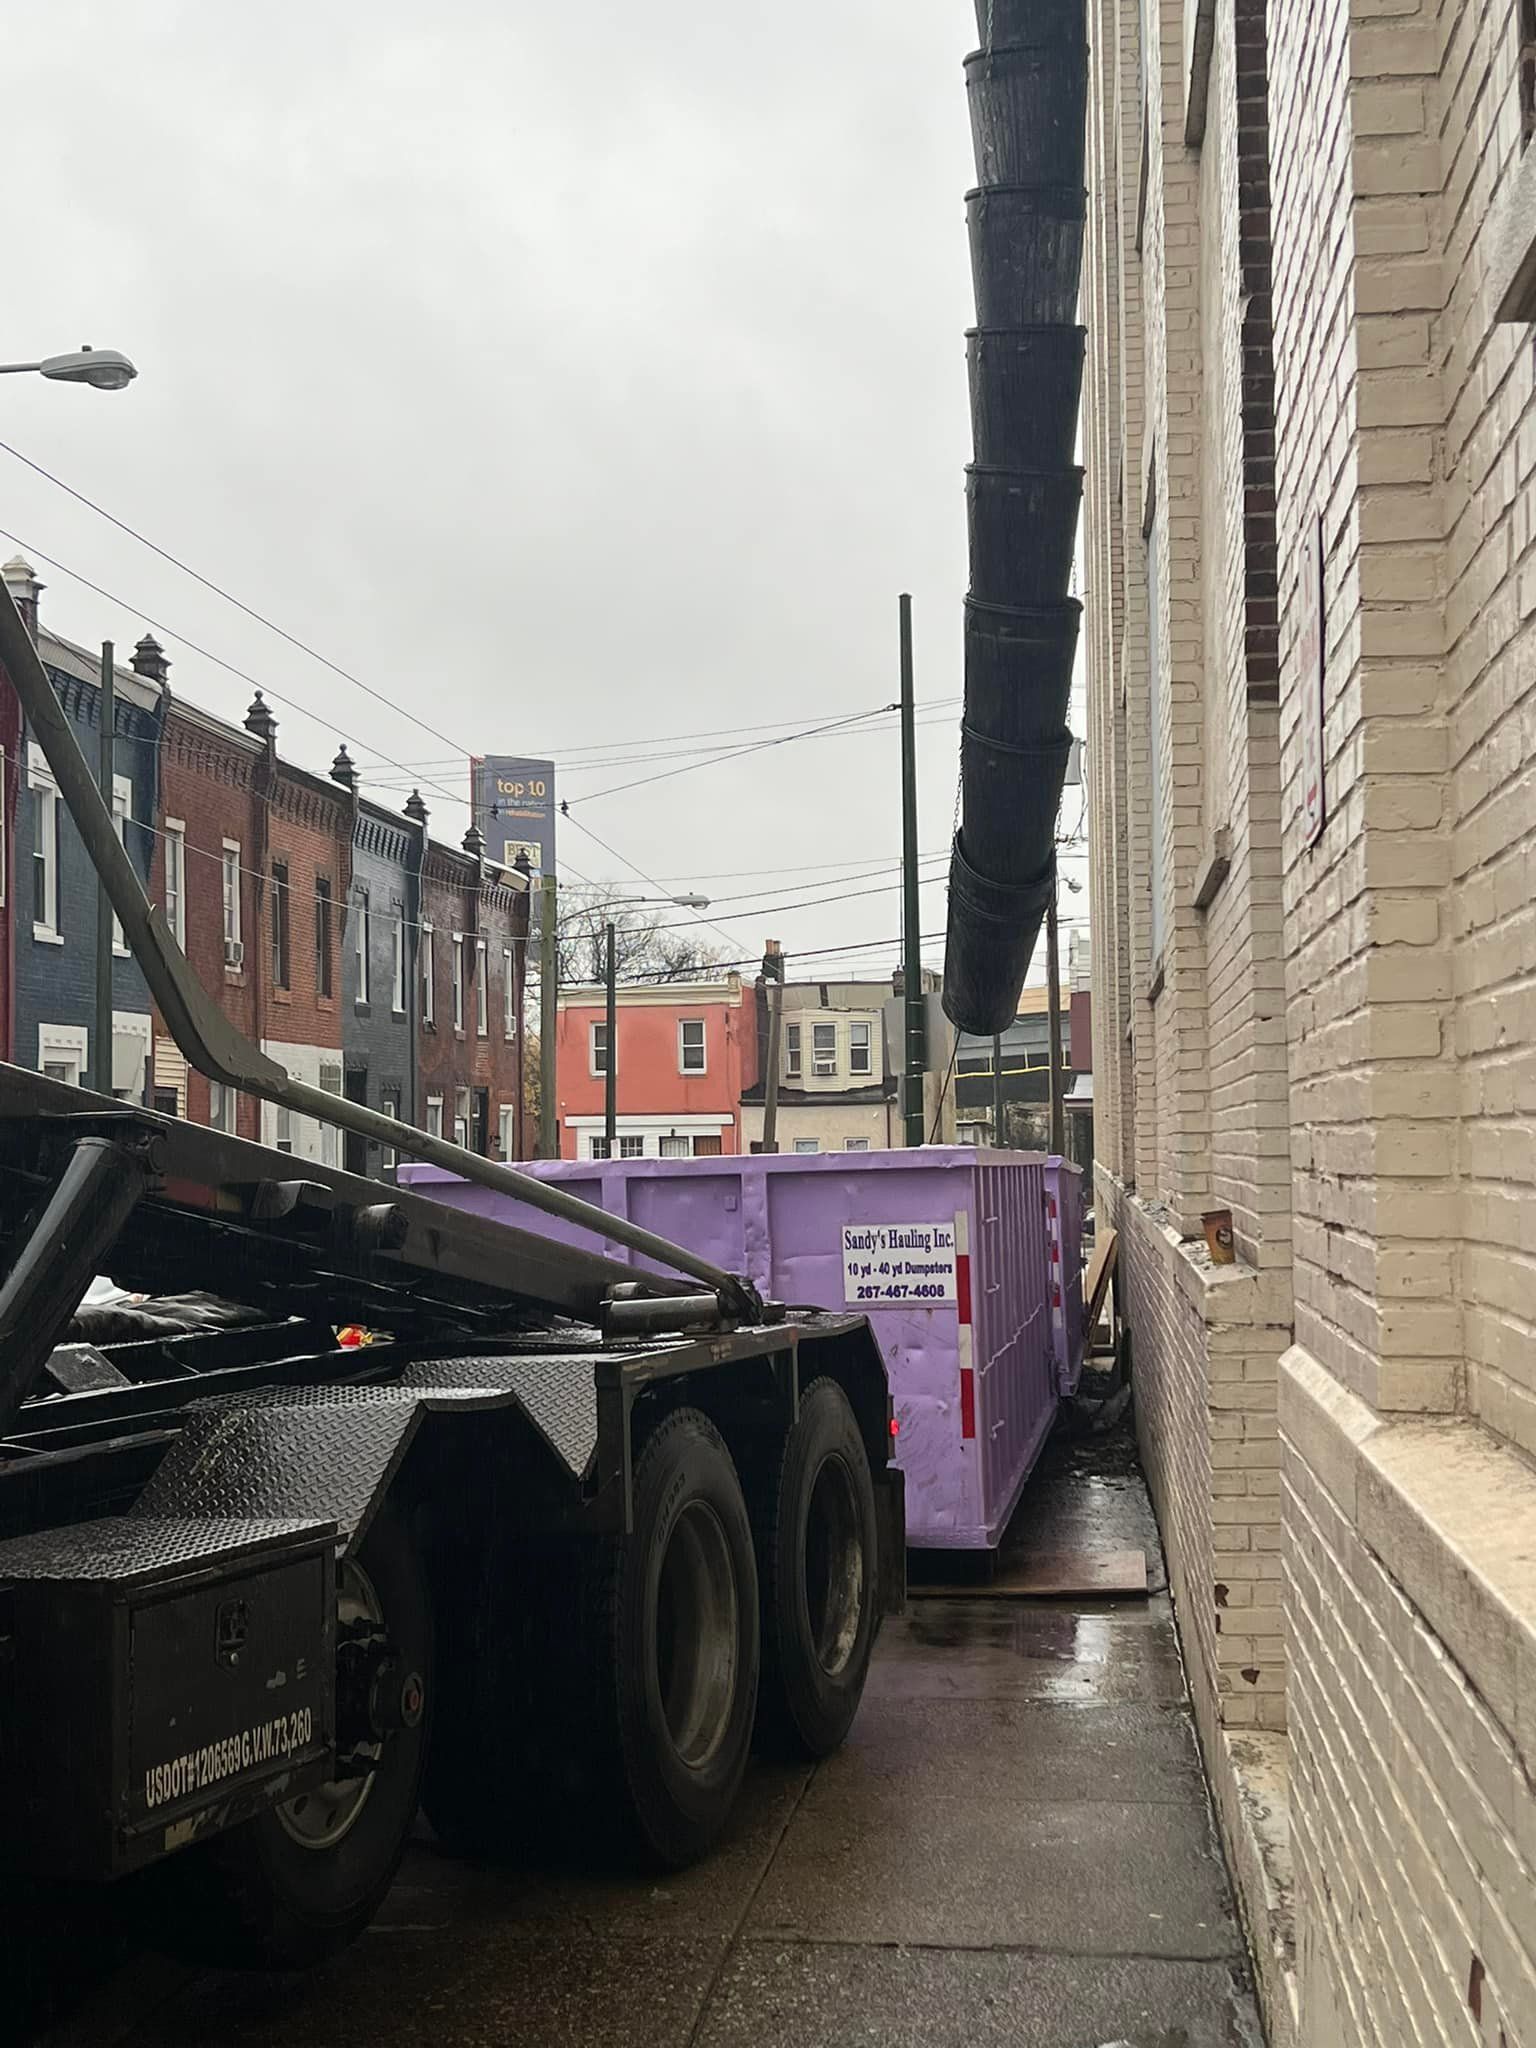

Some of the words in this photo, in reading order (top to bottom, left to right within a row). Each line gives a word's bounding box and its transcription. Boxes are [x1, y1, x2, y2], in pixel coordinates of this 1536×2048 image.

[496, 778, 525, 798] top
[528, 779, 546, 798] 10
[844, 1230, 886, 1254] Sandy's
[888, 1229, 932, 1253] Hauling
[934, 1228, 954, 1248] Inc.
[847, 1263, 859, 1276] 10
[861, 1262, 872, 1278] yd
[878, 1262, 890, 1275] 40
[892, 1261, 903, 1278] yd
[145, 1733, 241, 1808] USDOT#1206569
